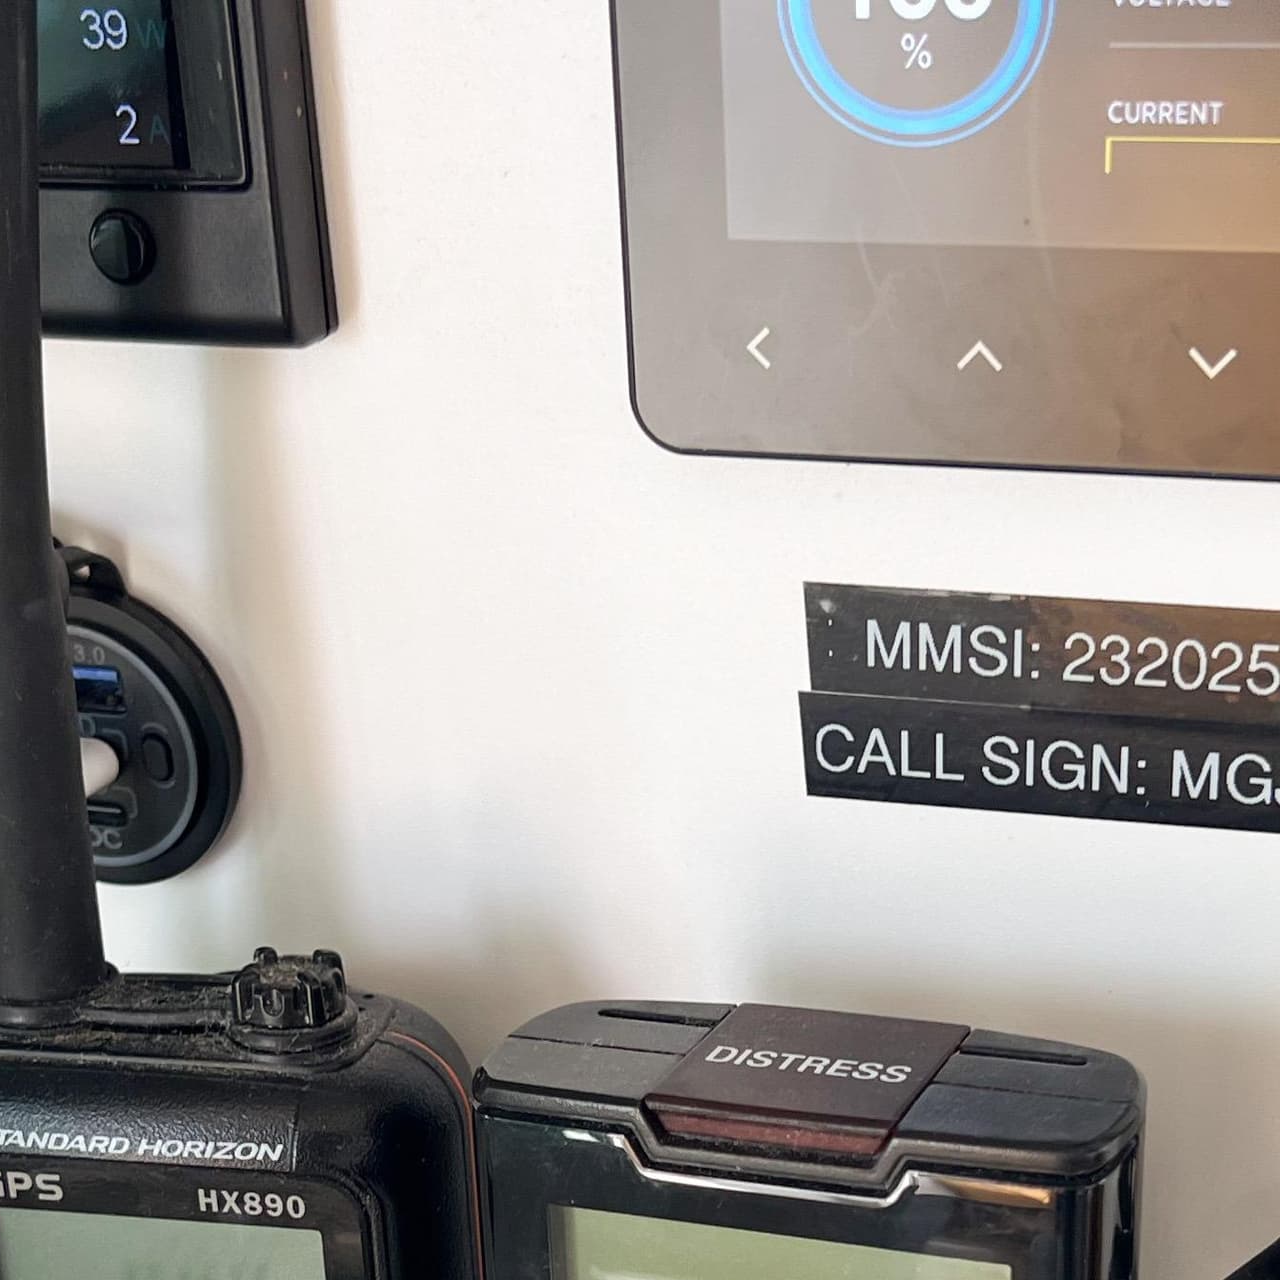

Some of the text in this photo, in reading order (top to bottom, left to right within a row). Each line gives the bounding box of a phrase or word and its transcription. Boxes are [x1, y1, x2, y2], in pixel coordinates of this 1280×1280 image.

[80, 10, 127, 51] 39
[116, 105, 140, 145] 2
[1107, 100, 1223, 126] CURRENT
[865, 618, 1042, 680] MMSI:
[814, 722, 965, 783] CALL
[980, 735, 1148, 797] SIGN:
[704, 1044, 912, 1085] DISTRESS
[136, 1138, 284, 1162] HORIZON
[197, 1189, 306, 1220] HX890
